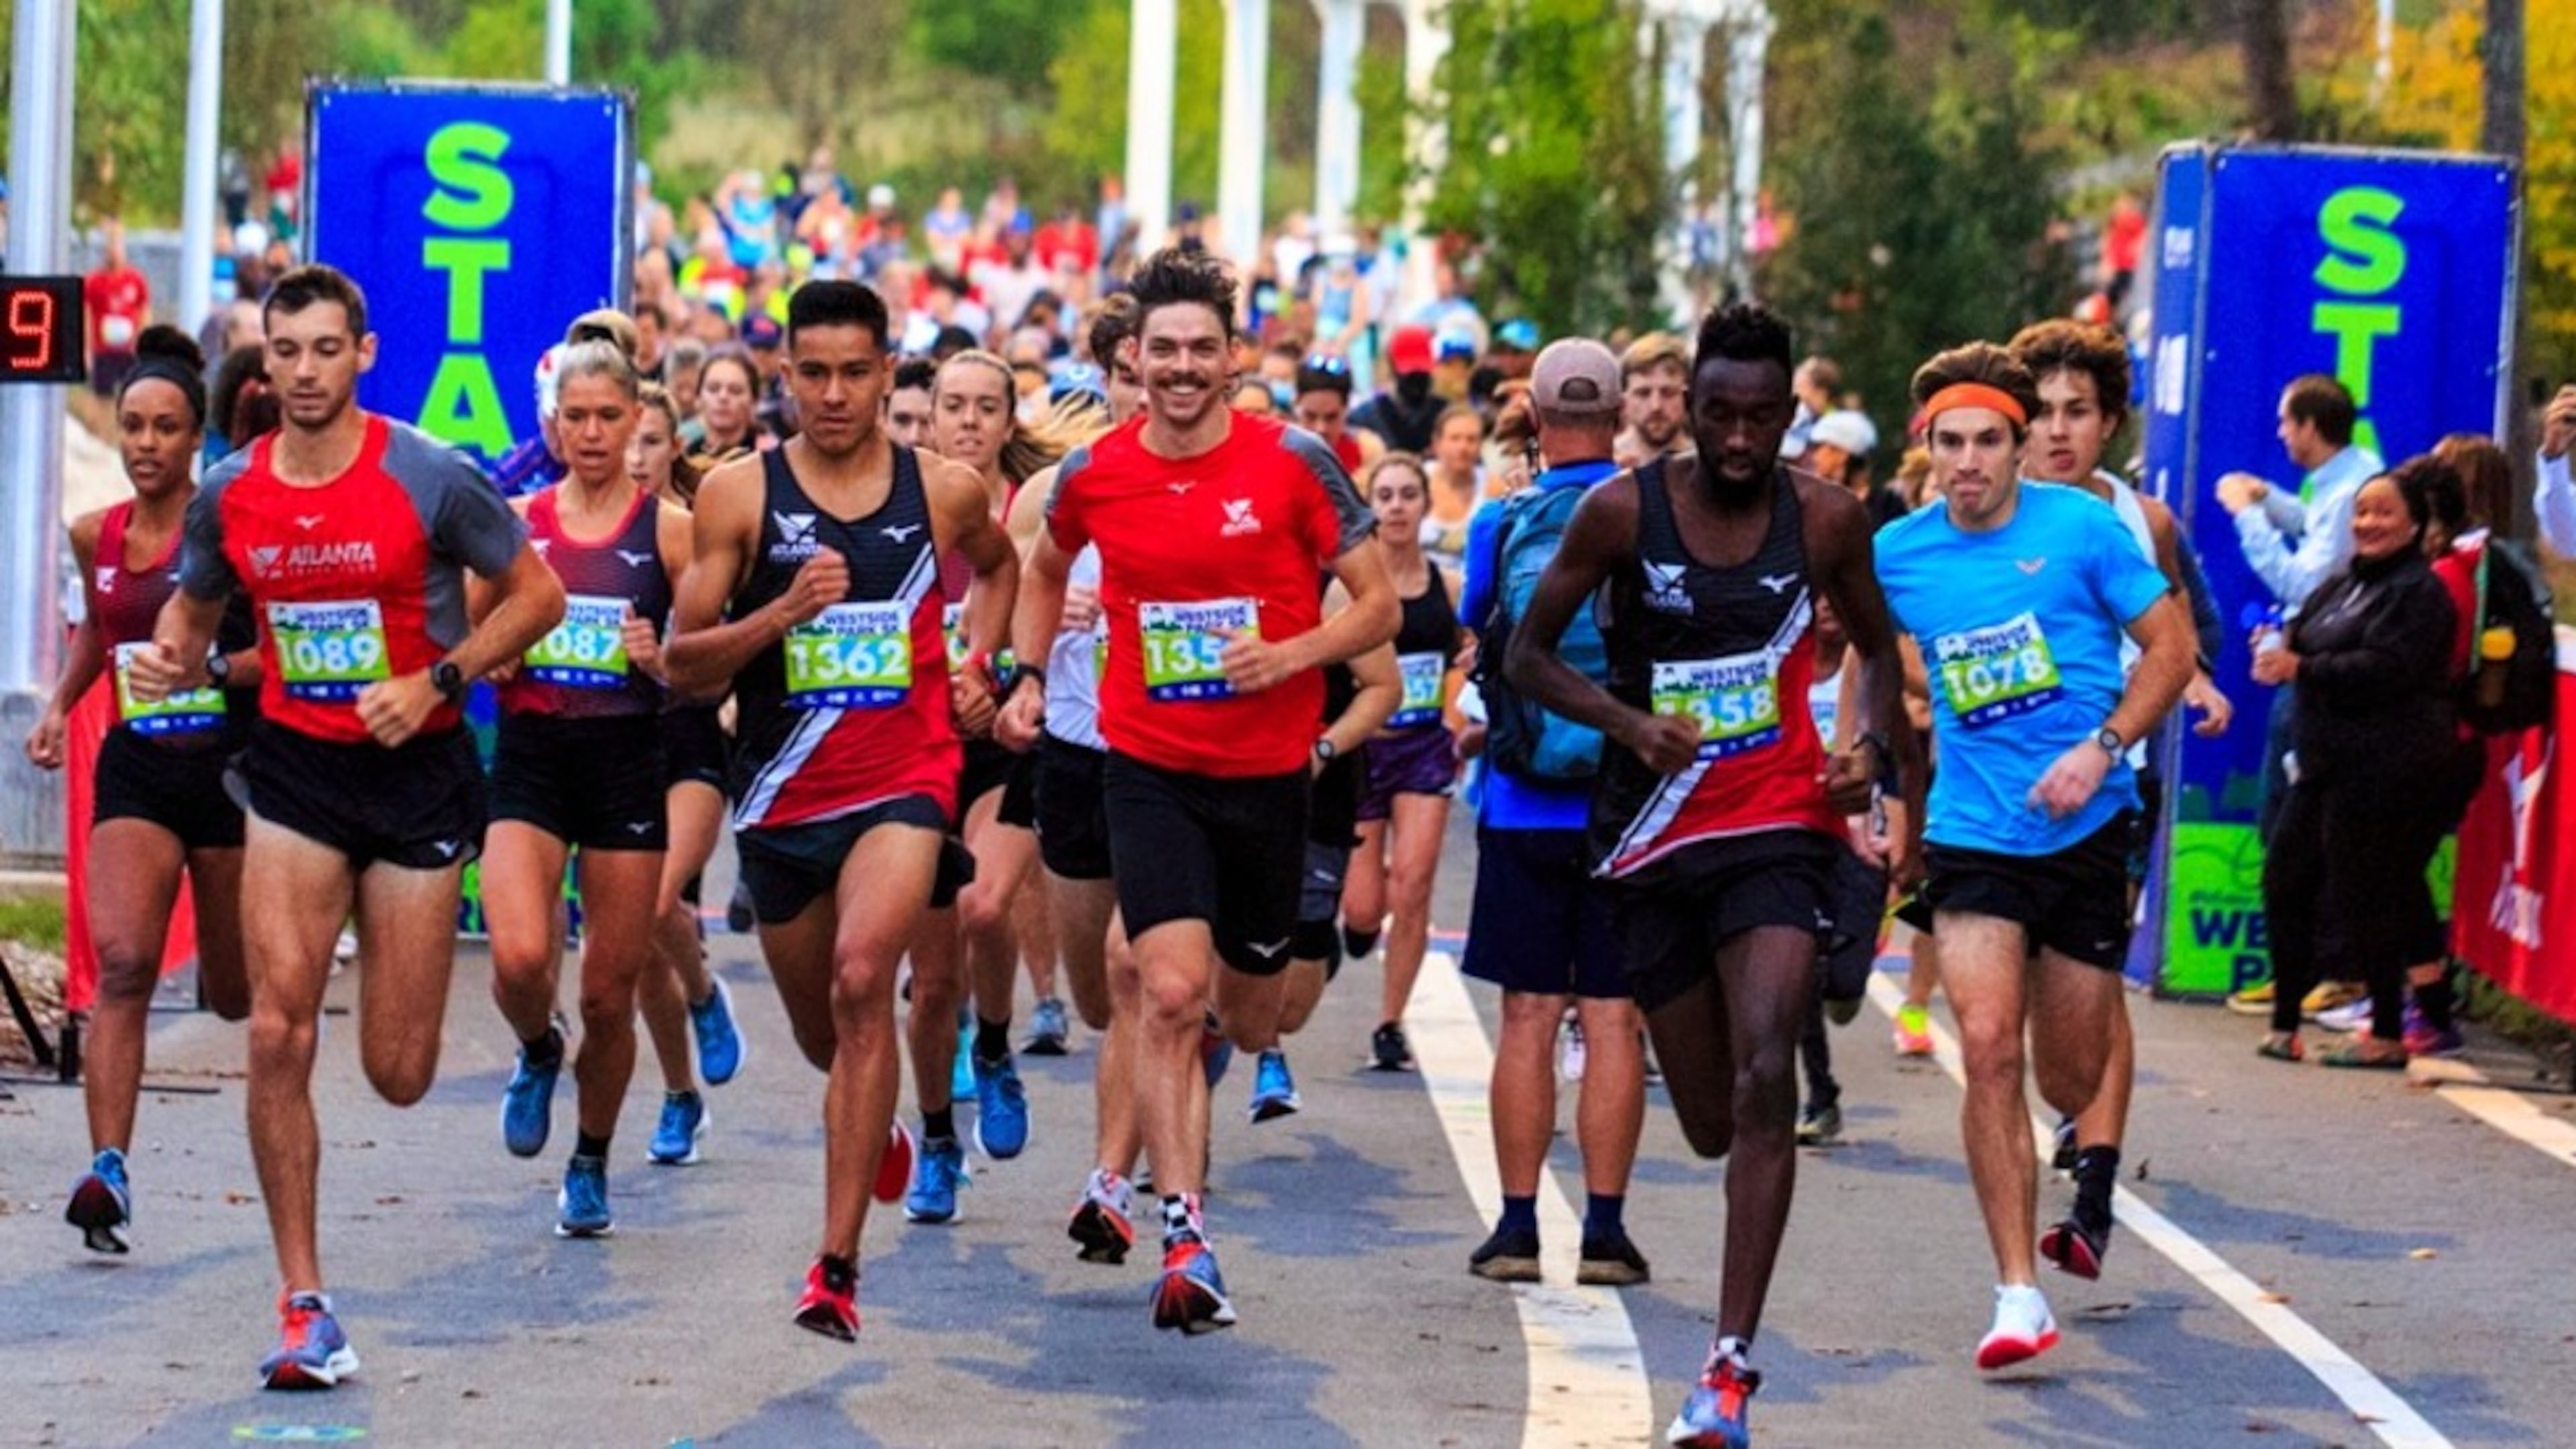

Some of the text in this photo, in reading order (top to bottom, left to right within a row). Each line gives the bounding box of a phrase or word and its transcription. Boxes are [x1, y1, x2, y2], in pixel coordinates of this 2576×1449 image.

[9, 290, 53, 368] 9
[2313, 186, 2406, 456] ST
[287, 541, 376, 566] ATLANTA
[274, 633, 381, 673] 1089
[790, 638, 906, 680] 1362
[1148, 636, 1225, 674] 135
[1945, 647, 2051, 702] 1078
